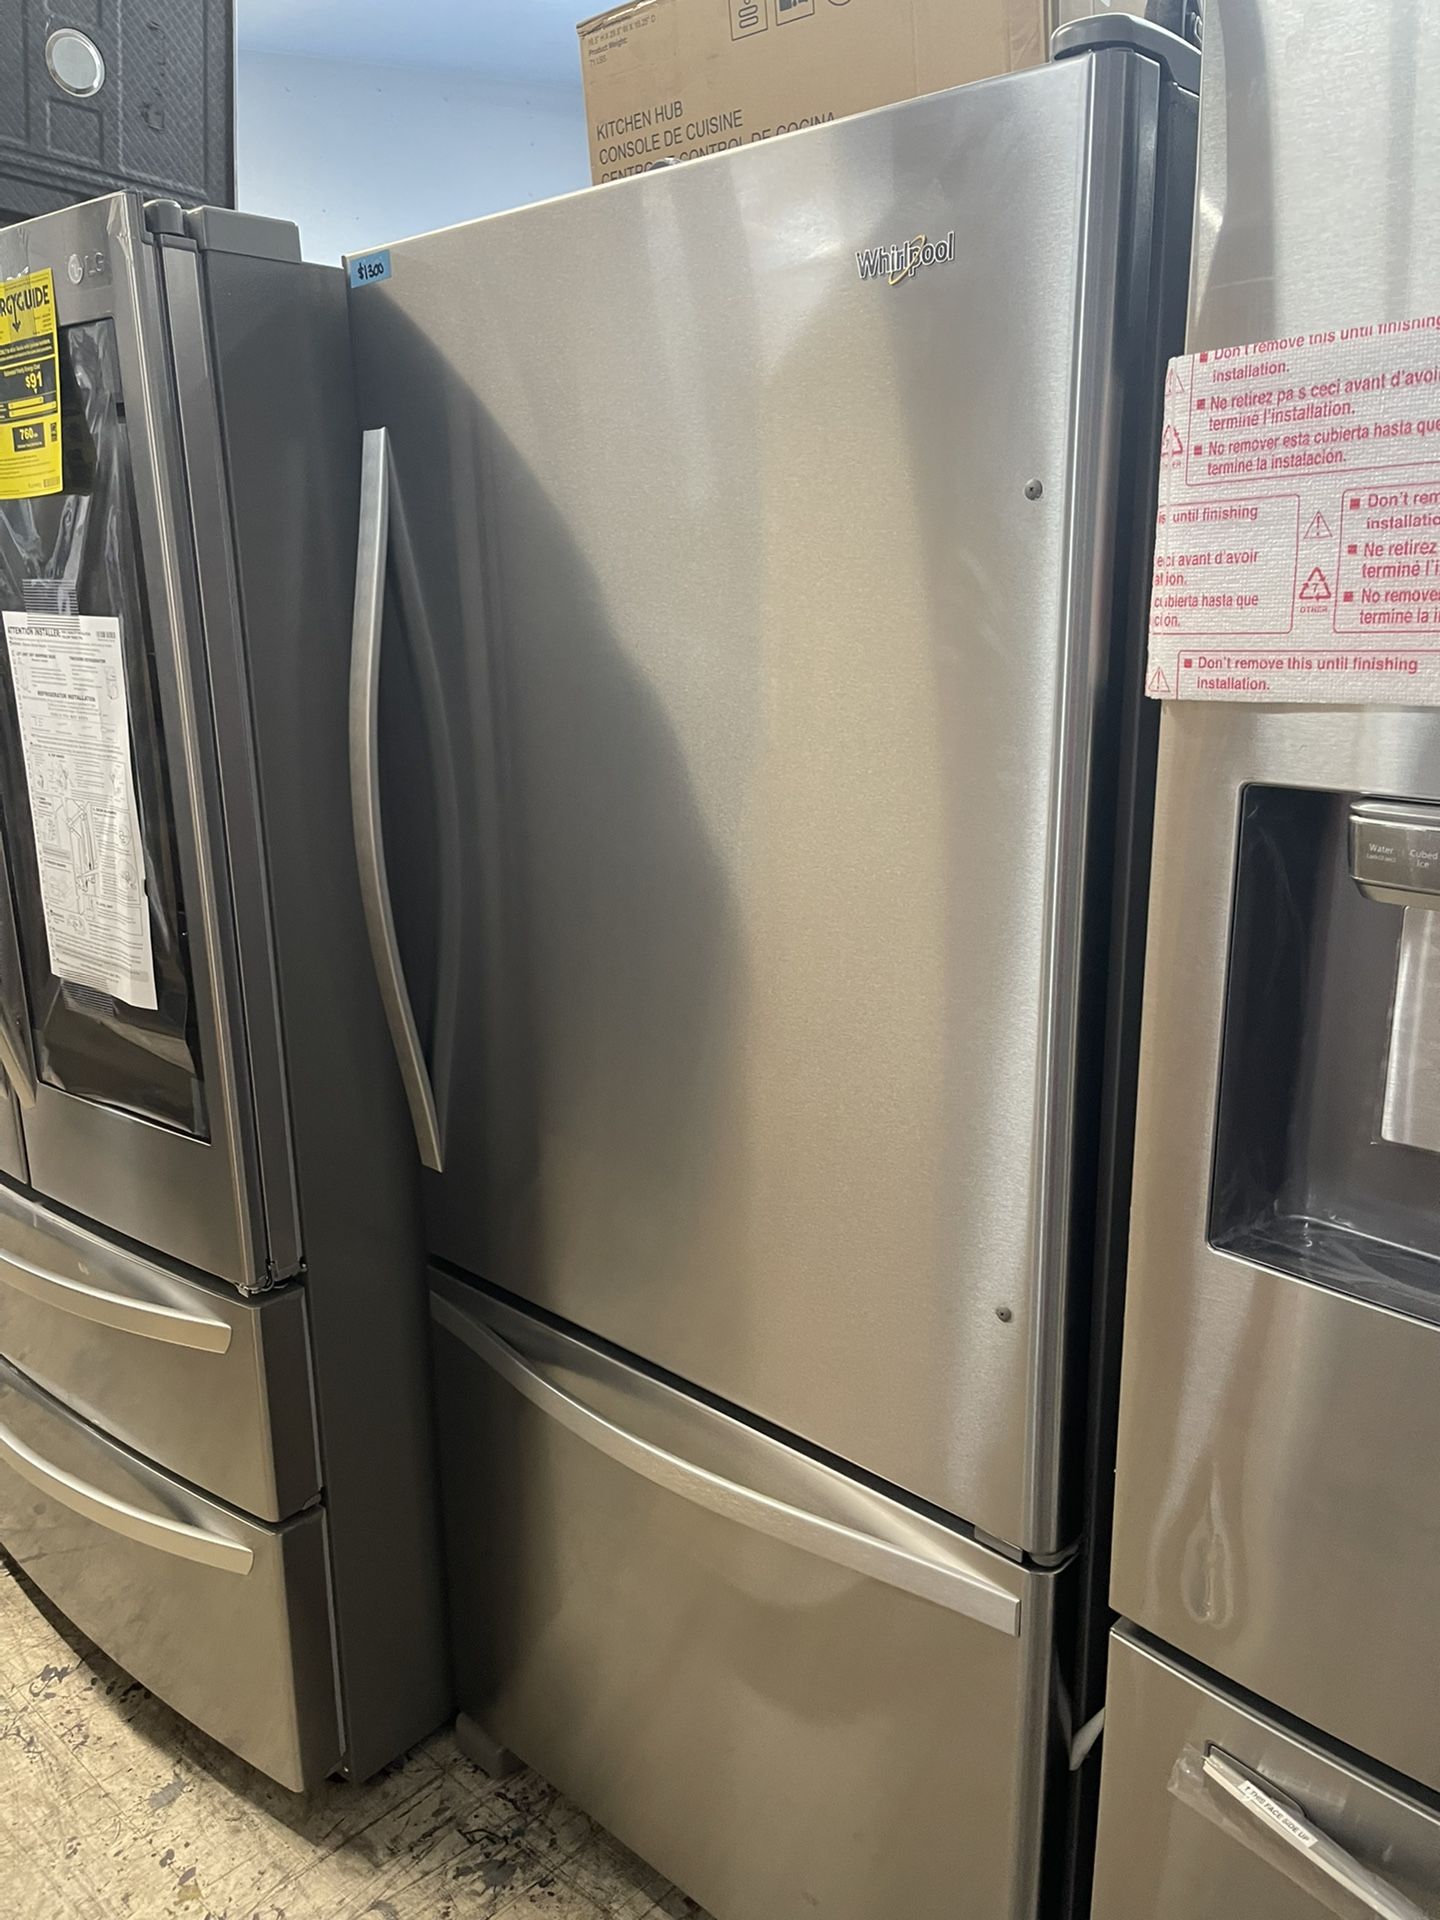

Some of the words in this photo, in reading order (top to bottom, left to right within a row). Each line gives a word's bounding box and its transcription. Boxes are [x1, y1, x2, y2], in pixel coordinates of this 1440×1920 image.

[596, 110, 652, 141] KITCHEN
[655, 101, 684, 122] HUB
[599, 133, 661, 165] CONSOLE
[664, 127, 683, 147] DE
[686, 109, 744, 141] CUISINE
[855, 230, 955, 278] Whirlpool
[357, 262, 385, 280] $1300
[1253, 336, 1305, 354] remove
[25, 371, 43, 389] $91
[1212, 361, 1290, 383] installation.
[1210, 396, 1228, 411] Ne
[1231, 390, 1273, 408] retirez
[1310, 378, 1341, 398] ceci
[1344, 373, 1386, 394] avant
[1263, 401, 1356, 425] l'installation.
[1208, 441, 1225, 456] No
[1228, 436, 1281, 454] remover
[1283, 431, 1311, 448] esta
[1314, 424, 1370, 444] cubierta
[1374, 420, 1413, 438] hasta
[1416, 418, 1440, 437] que
[1207, 457, 1253, 476] termine
[1256, 456, 1267, 471] la
[1368, 492, 1408, 508] Don't
[1173, 509, 1199, 523] until
[1202, 505, 1259, 522] finishing
[1178, 552, 1212, 566] avant
[1214, 548, 1260, 565] d'avoir
[1363, 542, 1384, 557] Ne
[1388, 540, 1438, 556] retirez
[1201, 591, 1233, 608] hasta
[1236, 594, 1259, 610] que
[1361, 588, 1381, 604] No
[1360, 608, 1413, 625] termine
[1416, 607, 1429, 624] la
[1198, 656, 1231, 670] Don't
[1234, 658, 1284, 670] remove
[1287, 656, 1313, 670] this
[1317, 656, 1348, 671] until
[1352, 656, 1419, 675] finishing
[1196, 676, 1271, 691] installation.
[1368, 843, 1394, 855] Water
[1409, 849, 1439, 861] Cubed
[1416, 859, 1430, 868] Ice
[1264, 1803, 1284, 1819] FACE
[1297, 1831, 1310, 1841] UP
